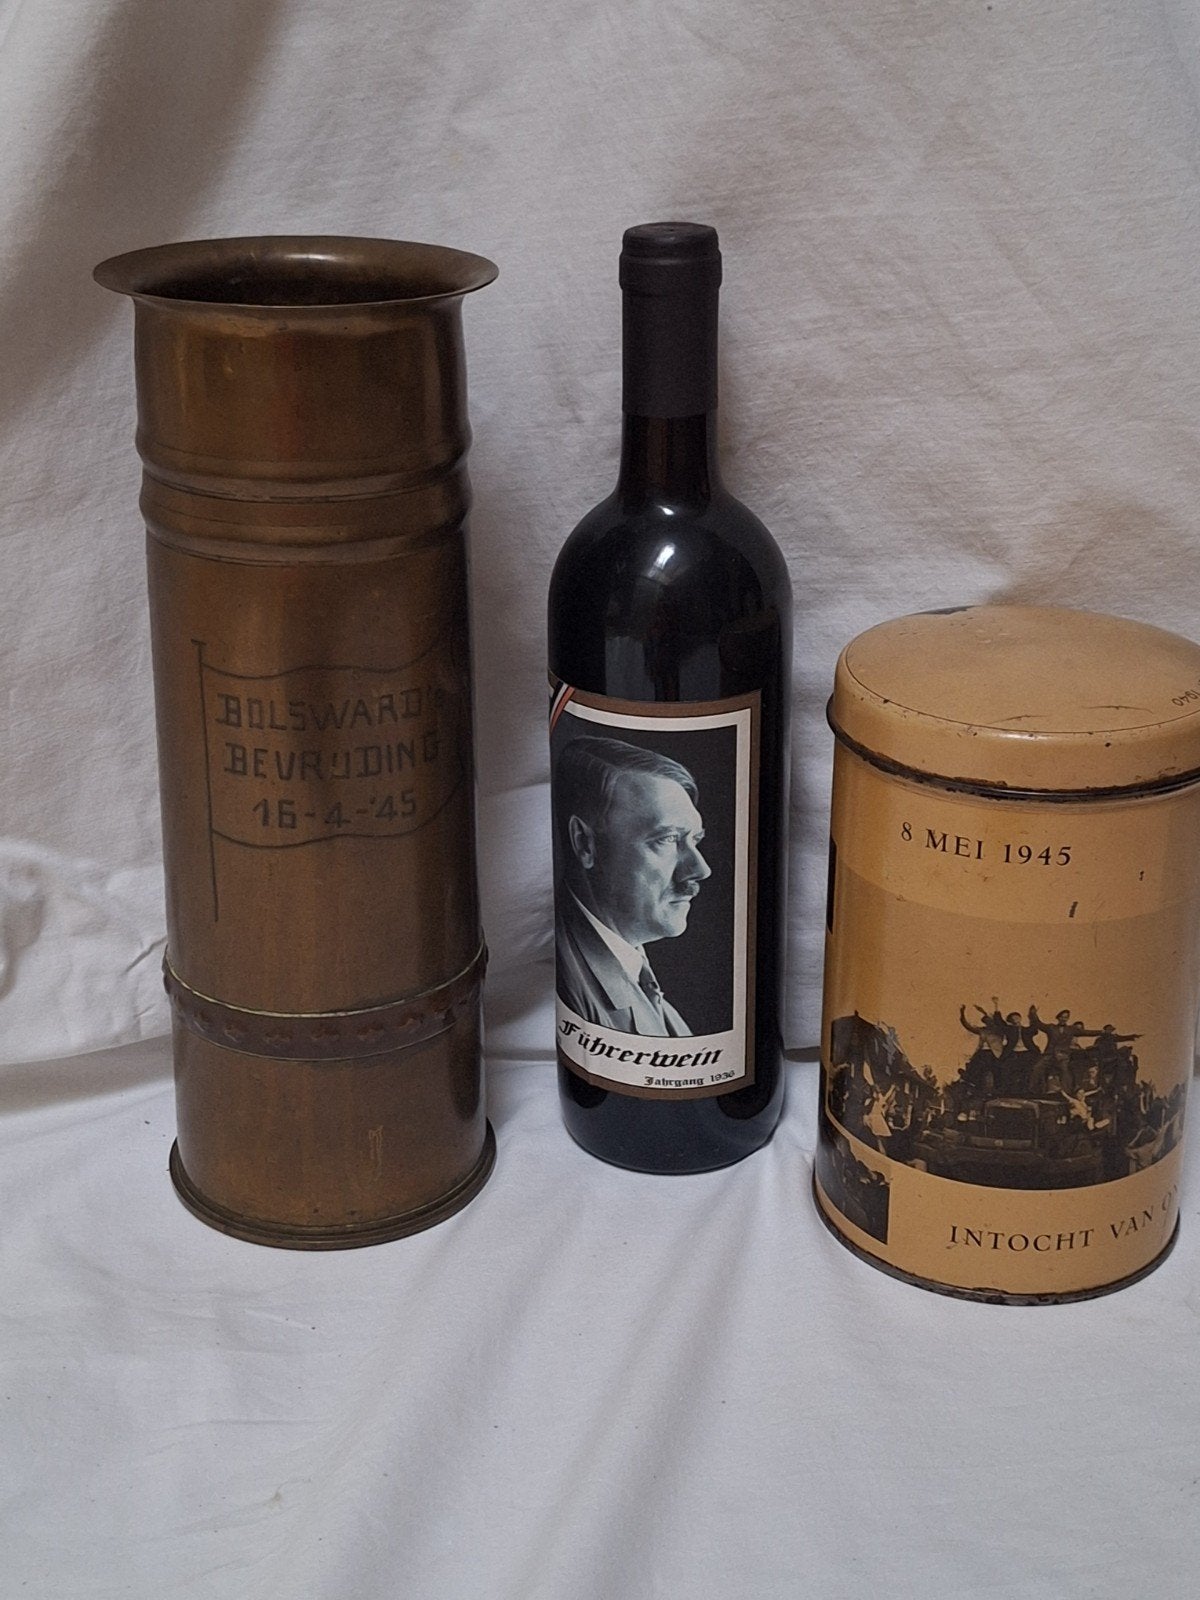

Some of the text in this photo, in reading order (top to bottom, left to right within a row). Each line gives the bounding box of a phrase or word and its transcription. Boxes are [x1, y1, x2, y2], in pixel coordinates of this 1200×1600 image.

[1171, 689, 1200, 707] 1940
[900, 821, 1072, 866] 8 MEI 1945
[558, 1019, 724, 1068] Führerwein
[644, 1076, 705, 1087] Jahrgang
[950, 1225, 1095, 1252] INTOCHT
[1109, 1205, 1155, 1240] VAN
